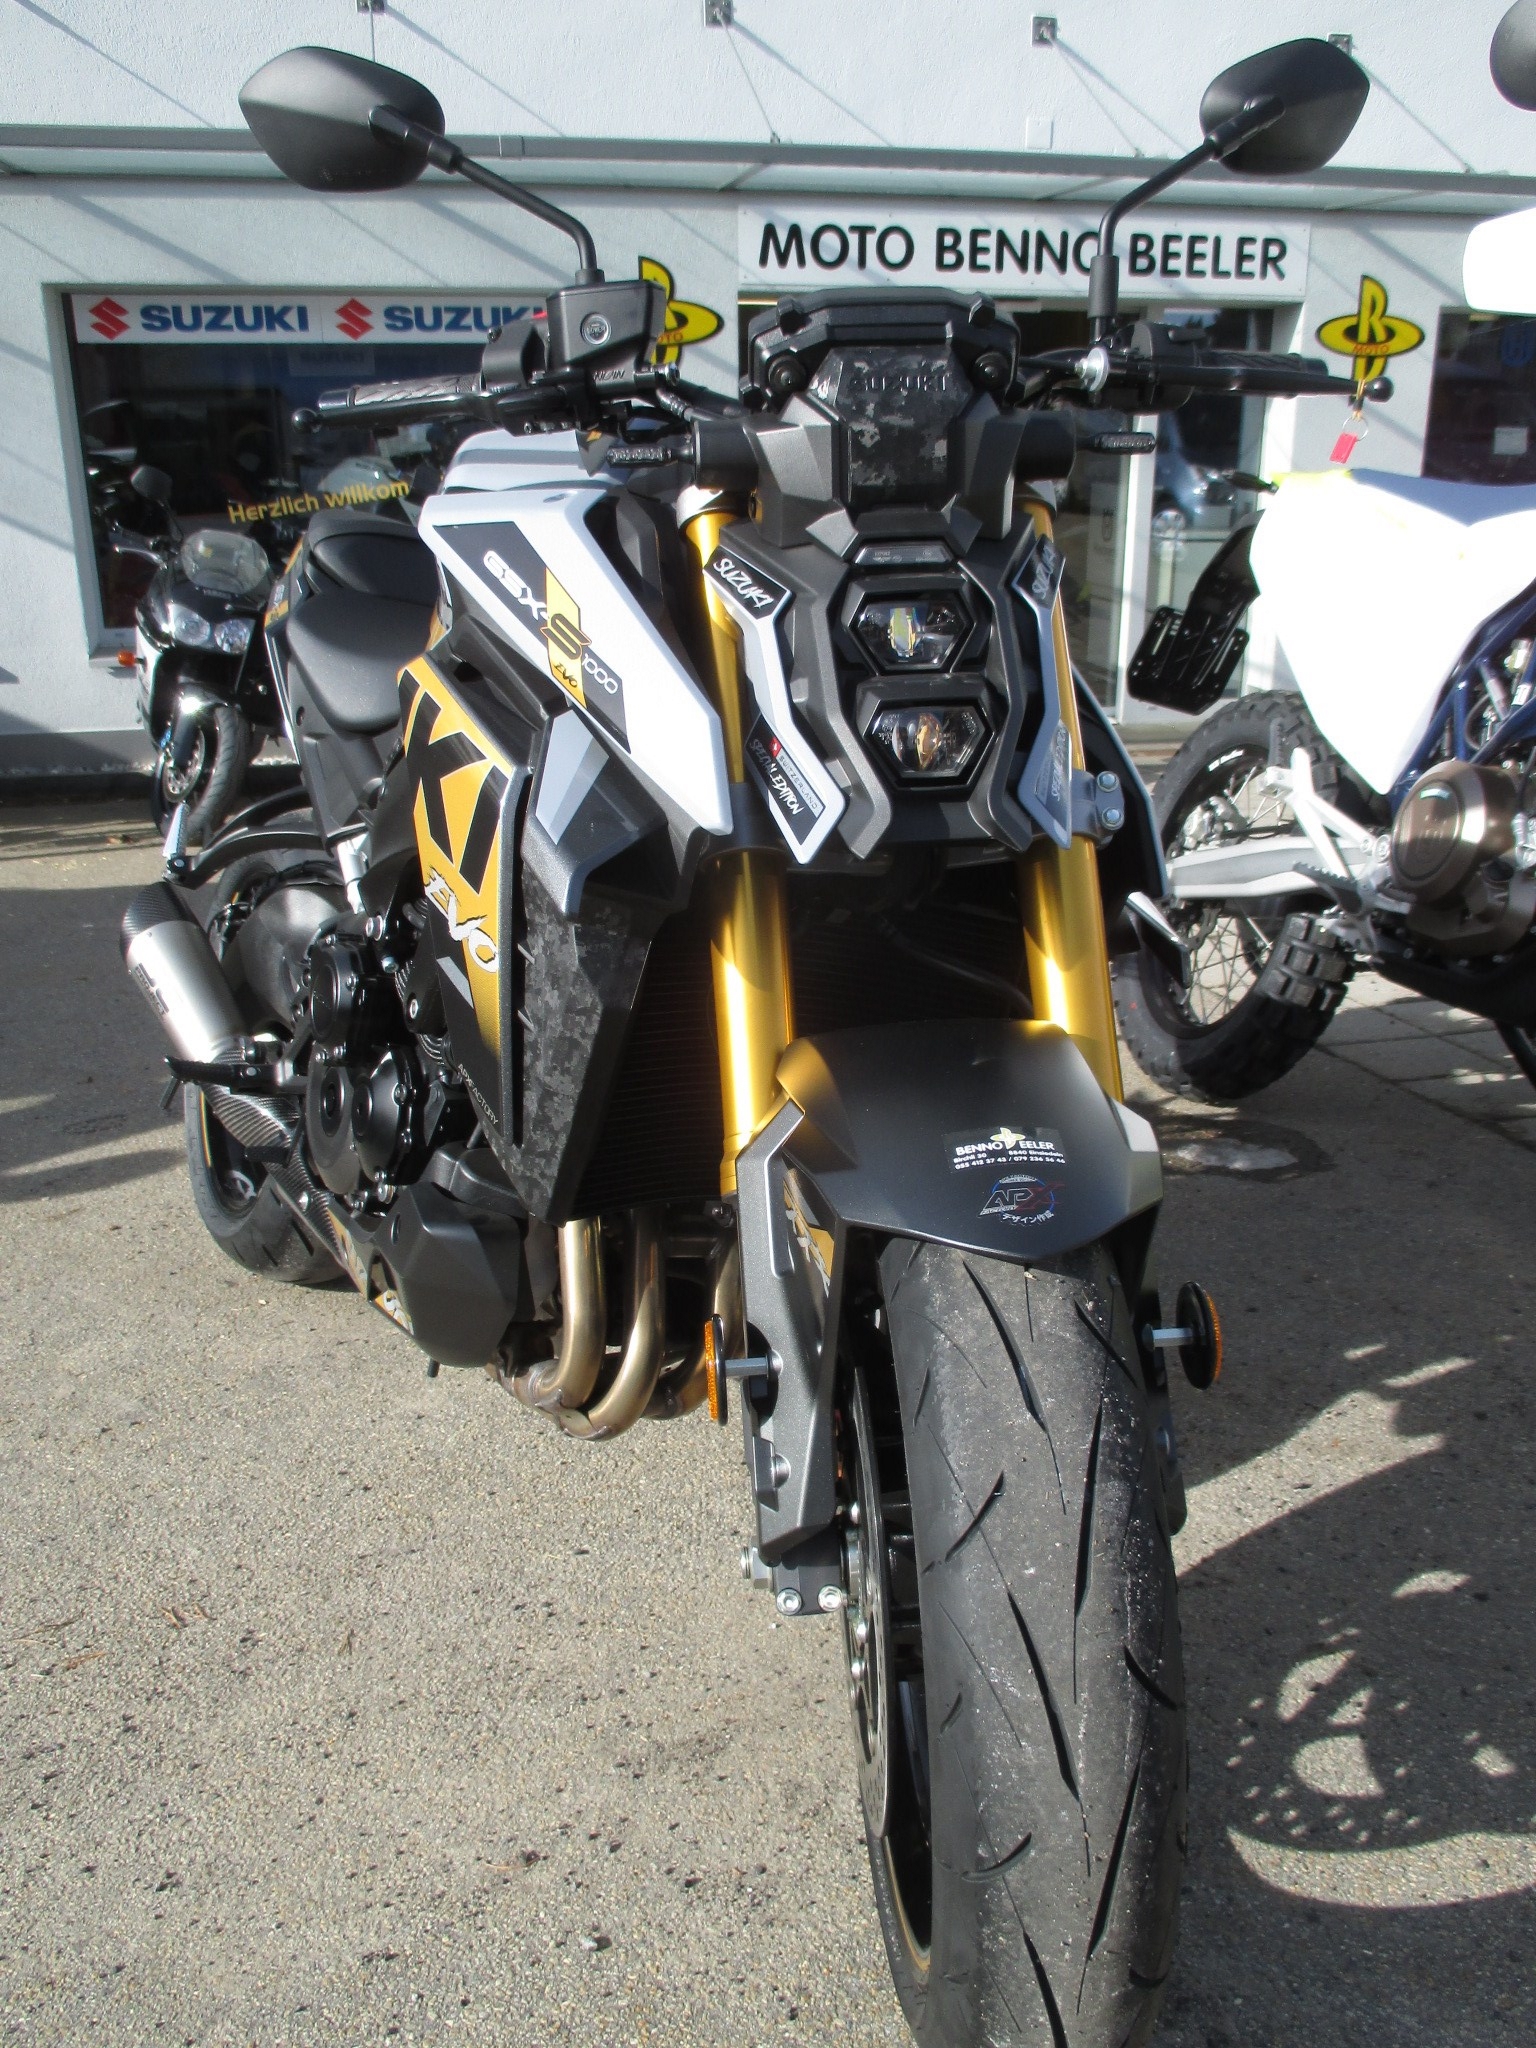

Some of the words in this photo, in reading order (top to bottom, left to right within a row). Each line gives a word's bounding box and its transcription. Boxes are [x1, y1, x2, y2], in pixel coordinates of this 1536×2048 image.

[759, 223, 915, 271] MOTO
[935, 227, 1099, 276] BENNO
[1128, 233, 1287, 281] BEELER
[140, 304, 310, 333] SUZUKI
[228, 493, 320, 524] Herzlich
[713, 558, 775, 609] SUZUKI
[554, 662, 578, 689] EVO
[582, 652, 619, 695] 1000
[771, 773, 806, 815] EDITION
[780, 755, 818, 810] SWITZERLAND
[423, 865, 499, 973] EVO
[955, 1141, 1003, 1156] BENNO
